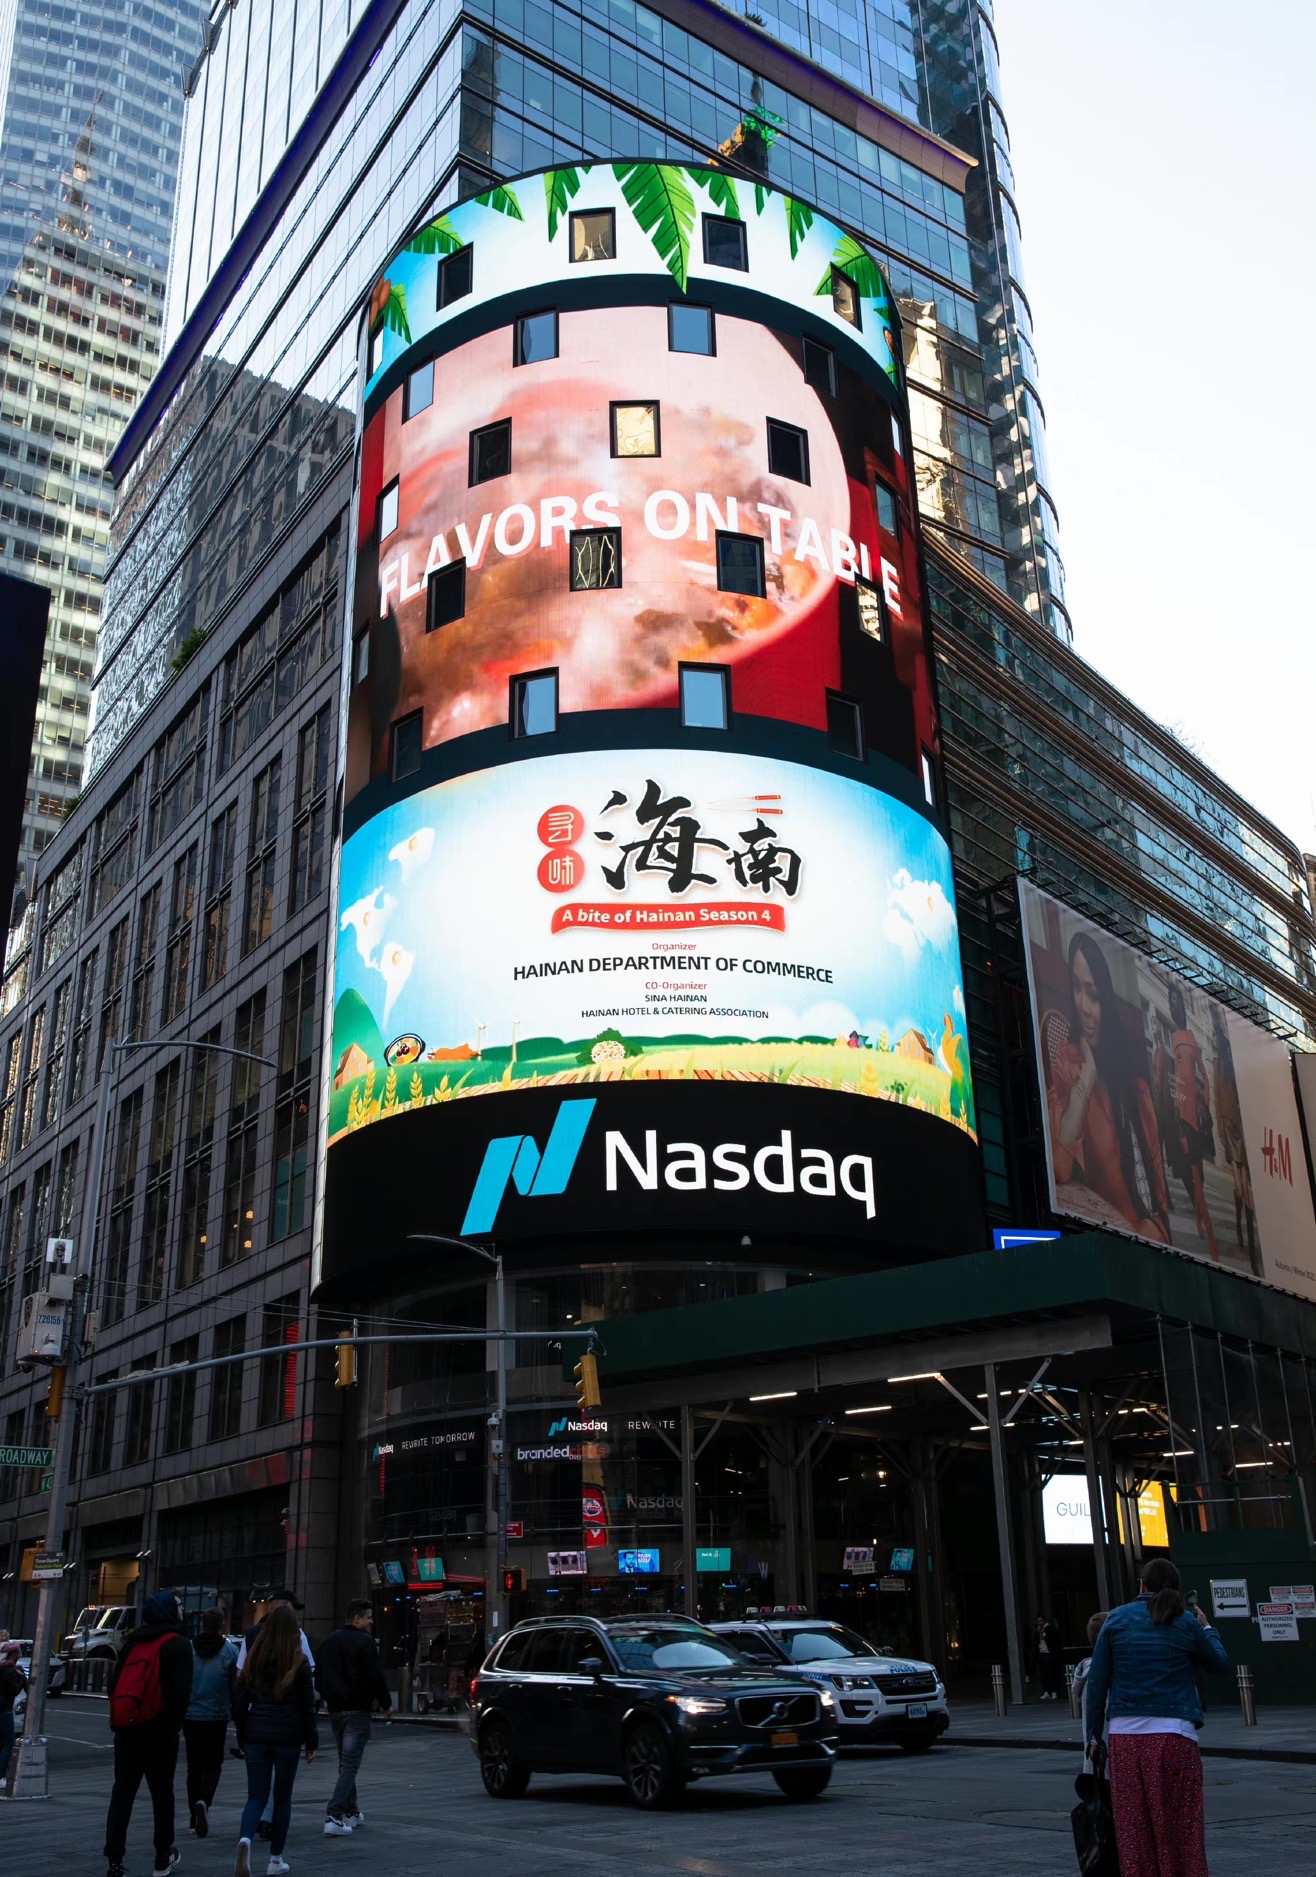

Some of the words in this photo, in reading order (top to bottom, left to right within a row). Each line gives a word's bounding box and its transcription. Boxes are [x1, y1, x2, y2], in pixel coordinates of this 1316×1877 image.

[380, 492, 621, 619] FLAVORS
[644, 490, 738, 540] ON
[594, 779, 801, 897] 海南
[562, 909, 573, 922] A
[577, 908, 610, 923] bite
[614, 908, 632, 923] of
[635, 908, 696, 923] Hainan
[699, 908, 758, 922] Season
[761, 909, 771, 922] 4
[651, 942, 697, 953] Organizer
[513, 958, 584, 981] HAINAN
[589, 955, 710, 973] DEPARTMENT
[715, 957, 739, 972] OF
[742, 959, 834, 984] COMMERCE
[645, 981, 707, 992] CO-Organizer
[645, 994, 667, 1003] SINA
[669, 994, 707, 1003] HAINAN
[581, 1008, 619, 1019] HAINAN
[621, 1007, 652, 1016] HOTEL
[661, 1007, 707, 1016] CATERING
[709, 1008, 769, 1019] ASSOCIATION
[1261, 1126, 1293, 1188] H&M
[605, 1129, 876, 1220] Nasdaq
[38, 1314, 61, 1325] 726156
[568, 1419, 608, 1432] Nasdaq
[402, 1438, 428, 1450] REWRITE
[431, 1432, 476, 1444] TOMORROW
[0, 1449, 49, 1465] ROADWAY
[517, 1445, 570, 1460] branded
[1214, 1587, 1245, 1598] PEDESTRIANS
